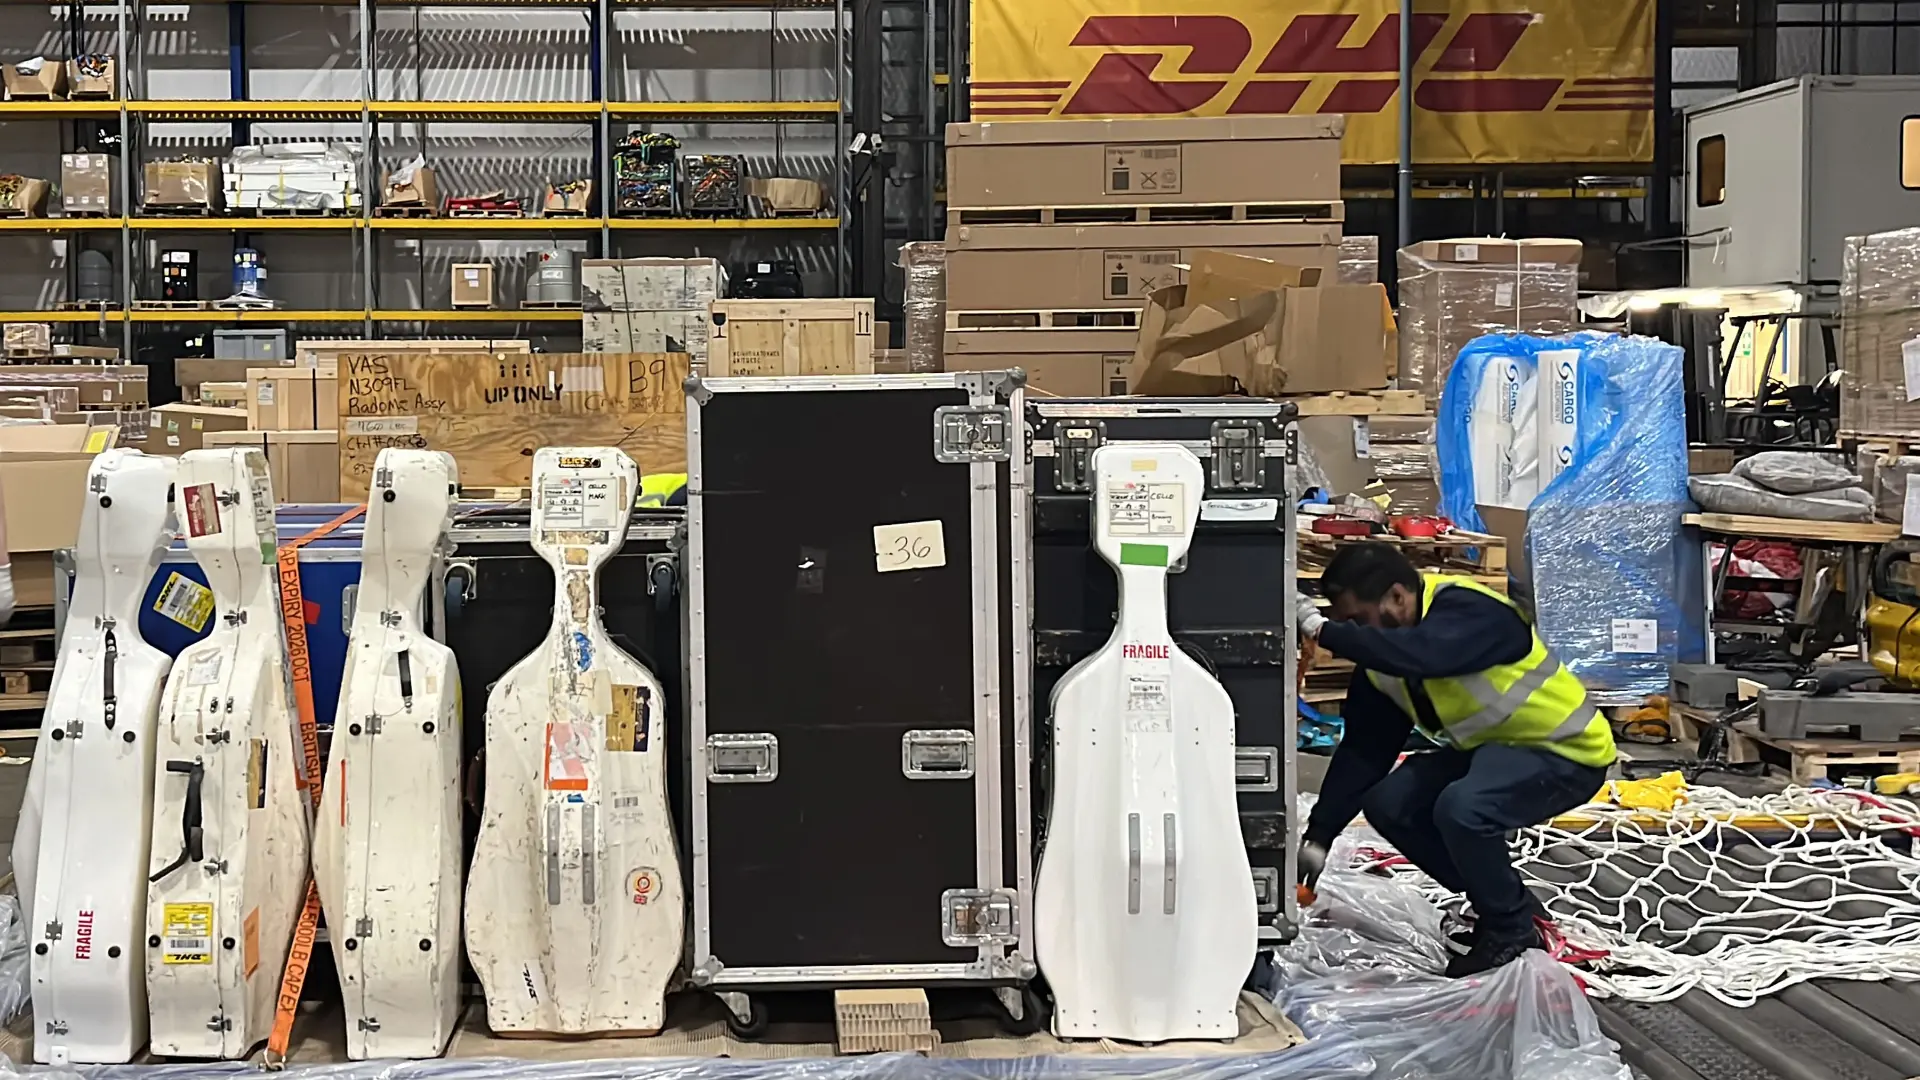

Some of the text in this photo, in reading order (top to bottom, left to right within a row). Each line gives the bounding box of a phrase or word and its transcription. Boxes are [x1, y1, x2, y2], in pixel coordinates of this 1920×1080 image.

[1061, 13, 1564, 114] DHL
[348, 356, 388, 375] VAS
[628, 359, 666, 394] B9
[349, 378, 416, 396] N309FL
[484, 383, 563, 404] UP ONLY
[1564, 381, 1574, 424] CARGO
[893, 536, 931, 565] 36
[159, 580, 176, 605] DHL
[282, 569, 302, 620] EXPIRY
[1123, 644, 1169, 659] FRAGILE
[300, 721, 319, 779] BRITISH
[75, 910, 94, 959] FRAGILE
[173, 953, 203, 961] DHL
[285, 963, 304, 994] CAP
